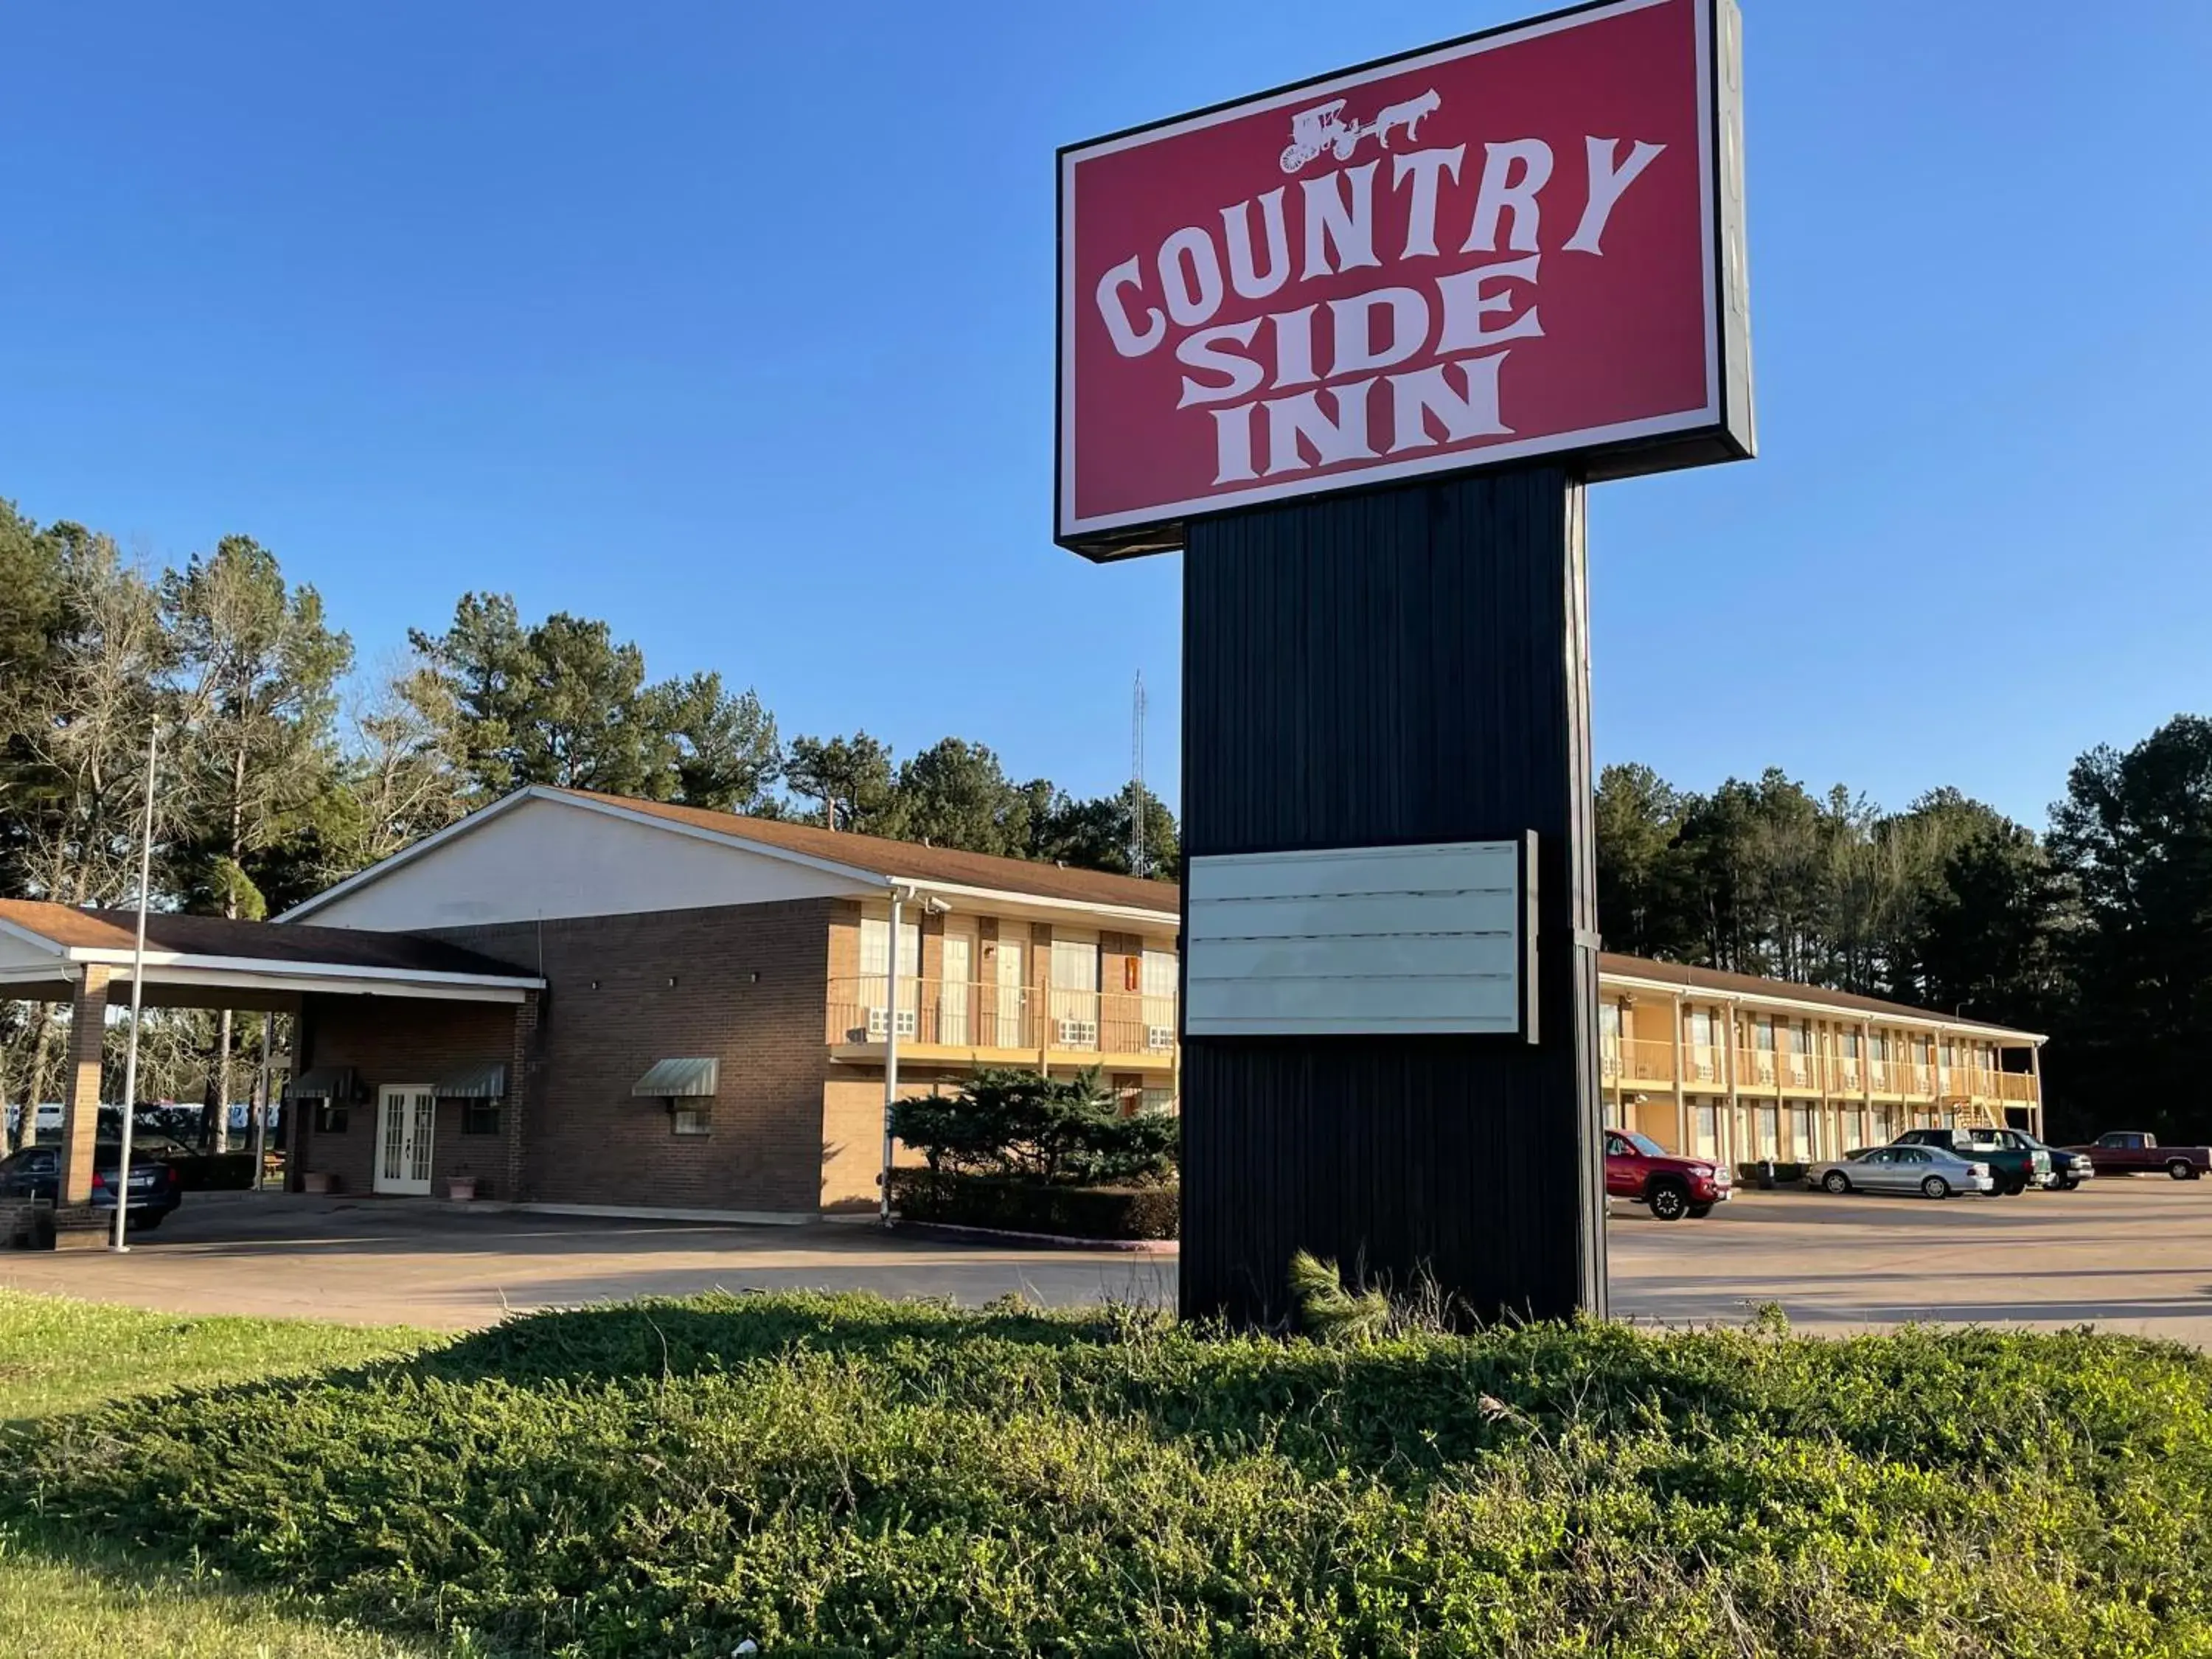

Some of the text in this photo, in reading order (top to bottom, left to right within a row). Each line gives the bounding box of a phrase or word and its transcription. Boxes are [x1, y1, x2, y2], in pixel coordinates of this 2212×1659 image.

[1096, 136, 1666, 358] COUNTRY
[1176, 254, 1545, 409] SIDE
[1208, 349, 1515, 485] INN
